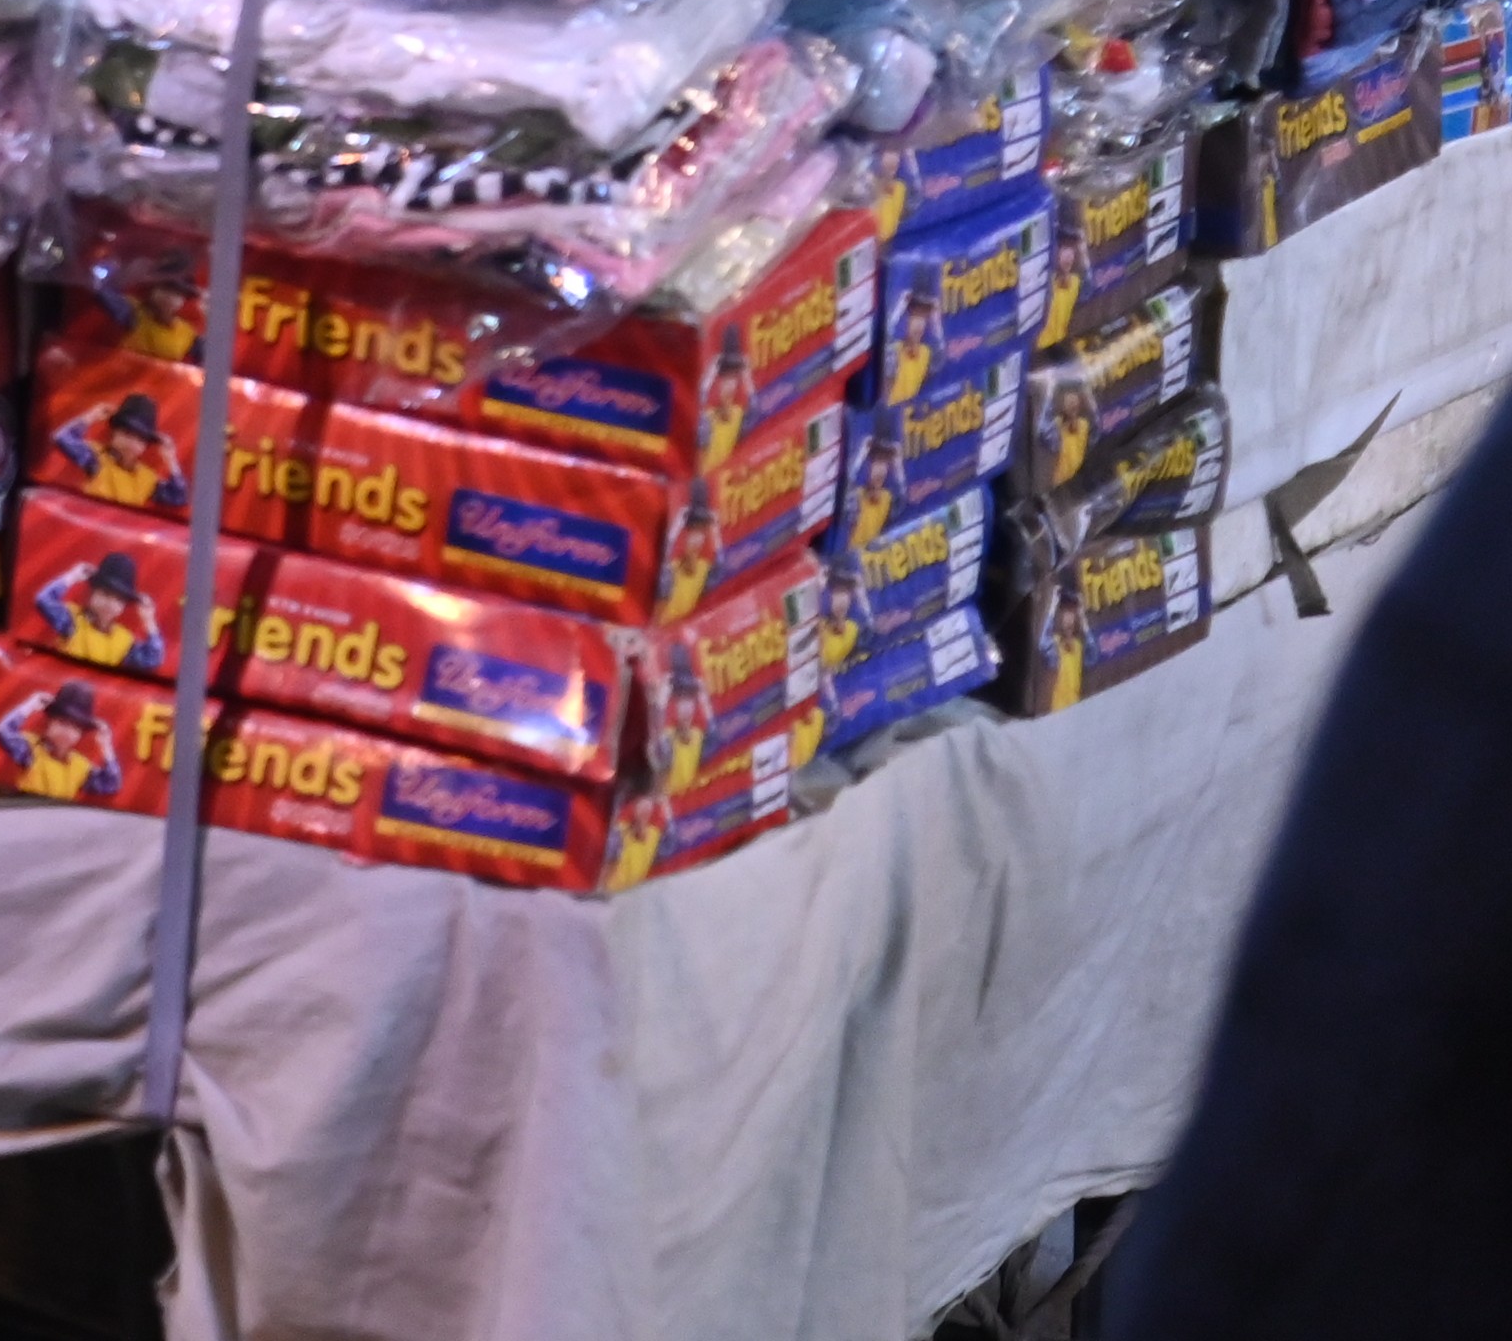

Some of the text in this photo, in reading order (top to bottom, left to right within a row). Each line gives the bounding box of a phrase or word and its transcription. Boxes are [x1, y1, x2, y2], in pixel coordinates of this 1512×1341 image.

[238, 275, 465, 385] Friends
[221, 423, 430, 533] riends
[180, 594, 574, 719] riends Unifor
[134, 702, 366, 806] Frends
